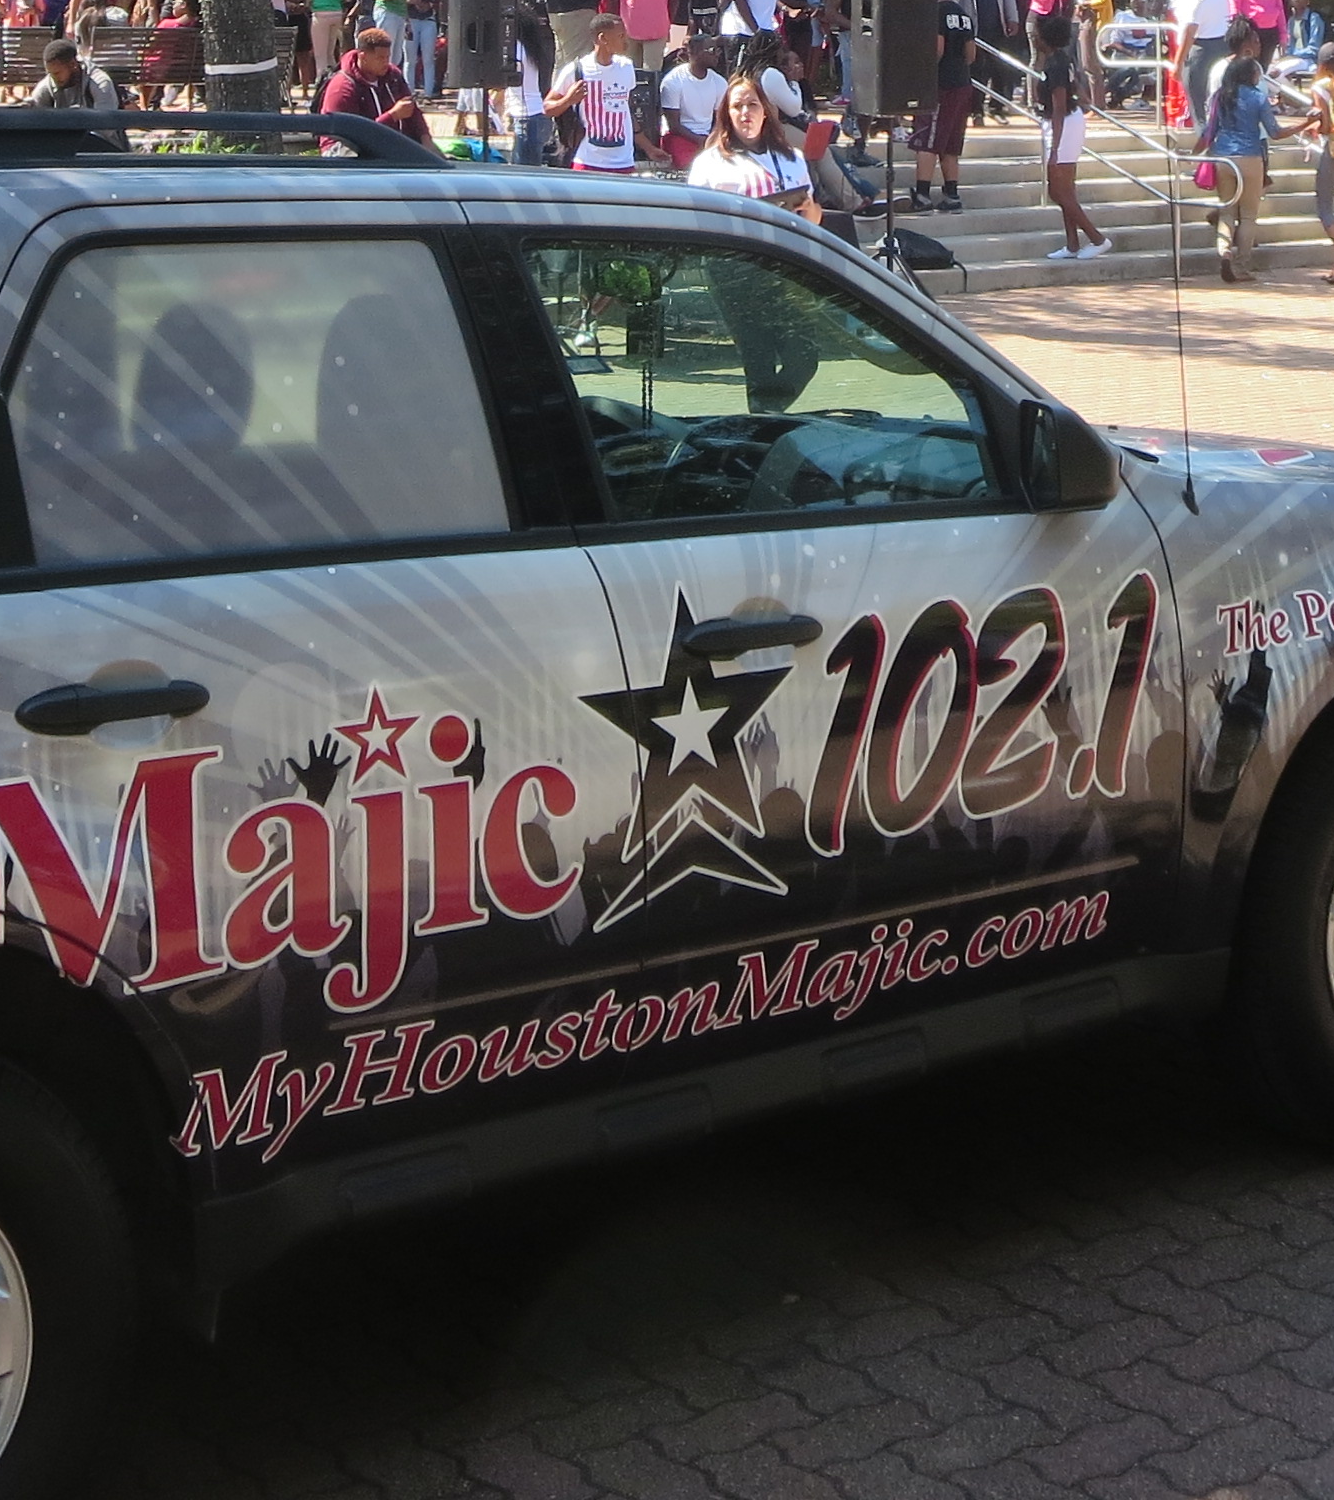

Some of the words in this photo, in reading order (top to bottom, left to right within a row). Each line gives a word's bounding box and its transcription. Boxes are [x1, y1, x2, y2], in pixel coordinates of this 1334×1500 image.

[805, 568, 1159, 857] 102.1
[1217, 596, 1291, 658] The
[168, 886, 1113, 1163] MyHoustonMajic.com
